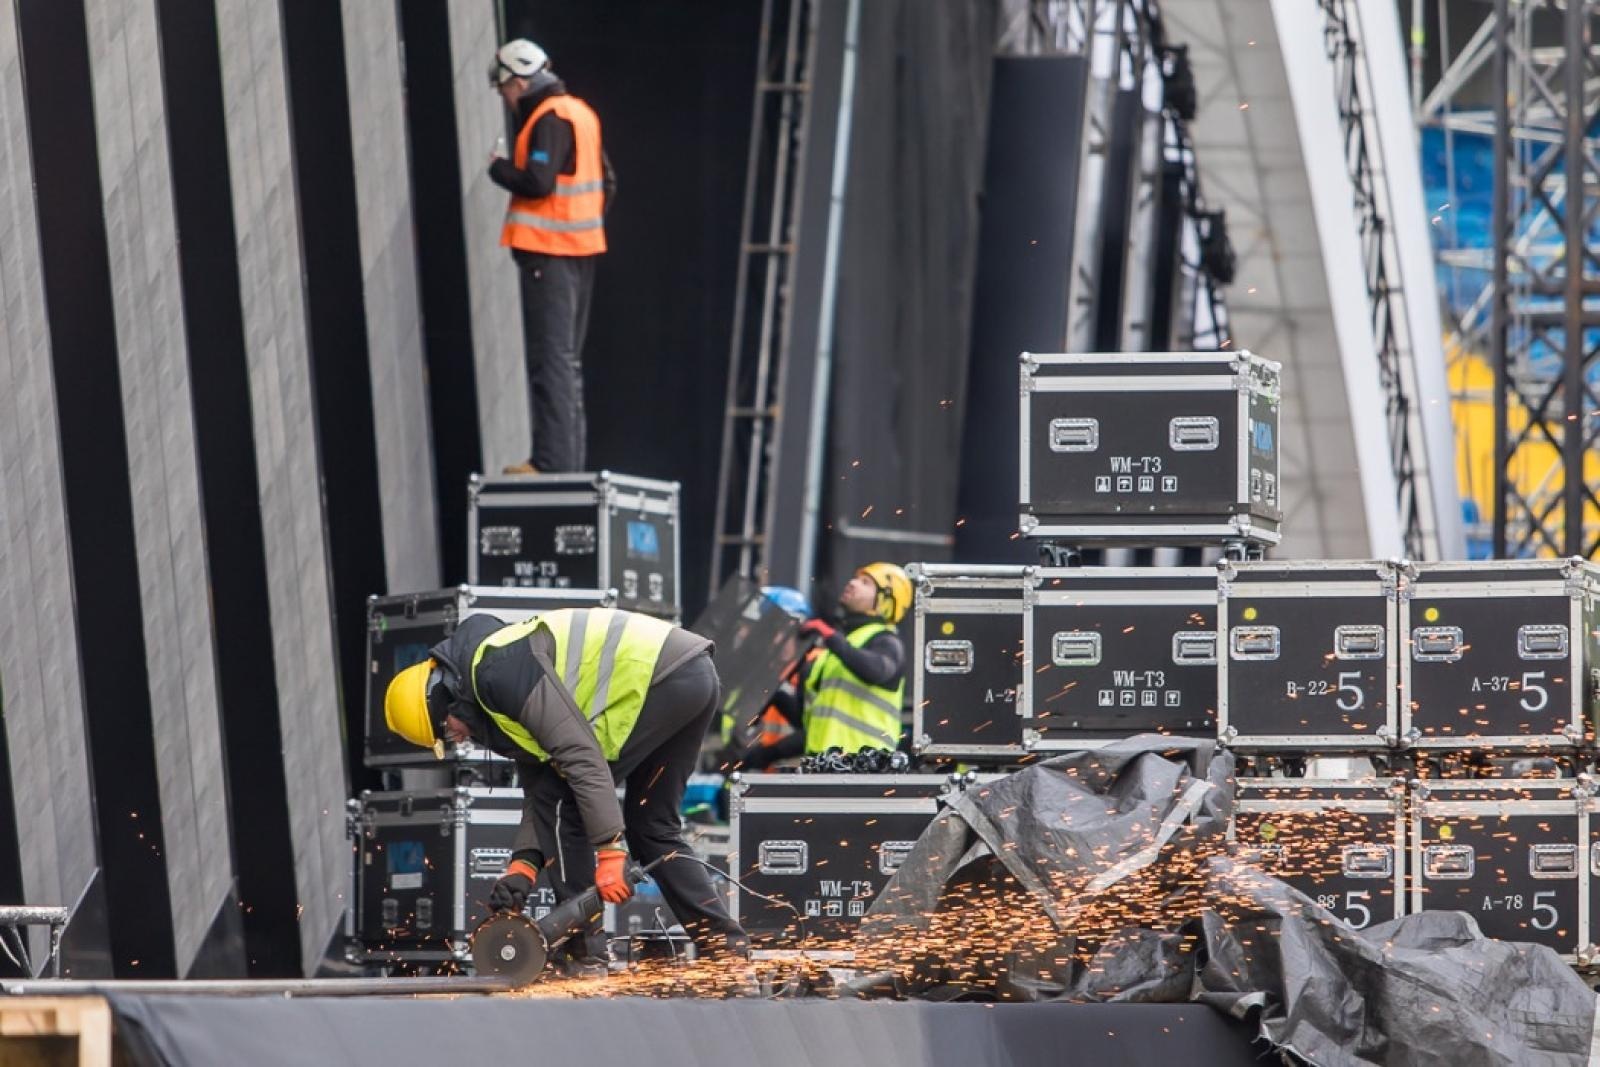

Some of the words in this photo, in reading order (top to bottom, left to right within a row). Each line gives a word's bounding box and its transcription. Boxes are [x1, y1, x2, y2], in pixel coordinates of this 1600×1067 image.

[1110, 456, 1162, 473] WM-T3
[514, 561, 559, 577] WM-T3
[1113, 670, 1165, 688] WM-T3
[1286, 681, 1328, 698] B-22
[1336, 671, 1364, 711] 5
[1471, 676, 1510, 692] A-37
[1520, 671, 1548, 712] 5
[820, 880, 874, 898] WM-T3
[1343, 890, 1370, 930] 5
[1482, 894, 1523, 910] A-78
[1531, 890, 1559, 930] 5
